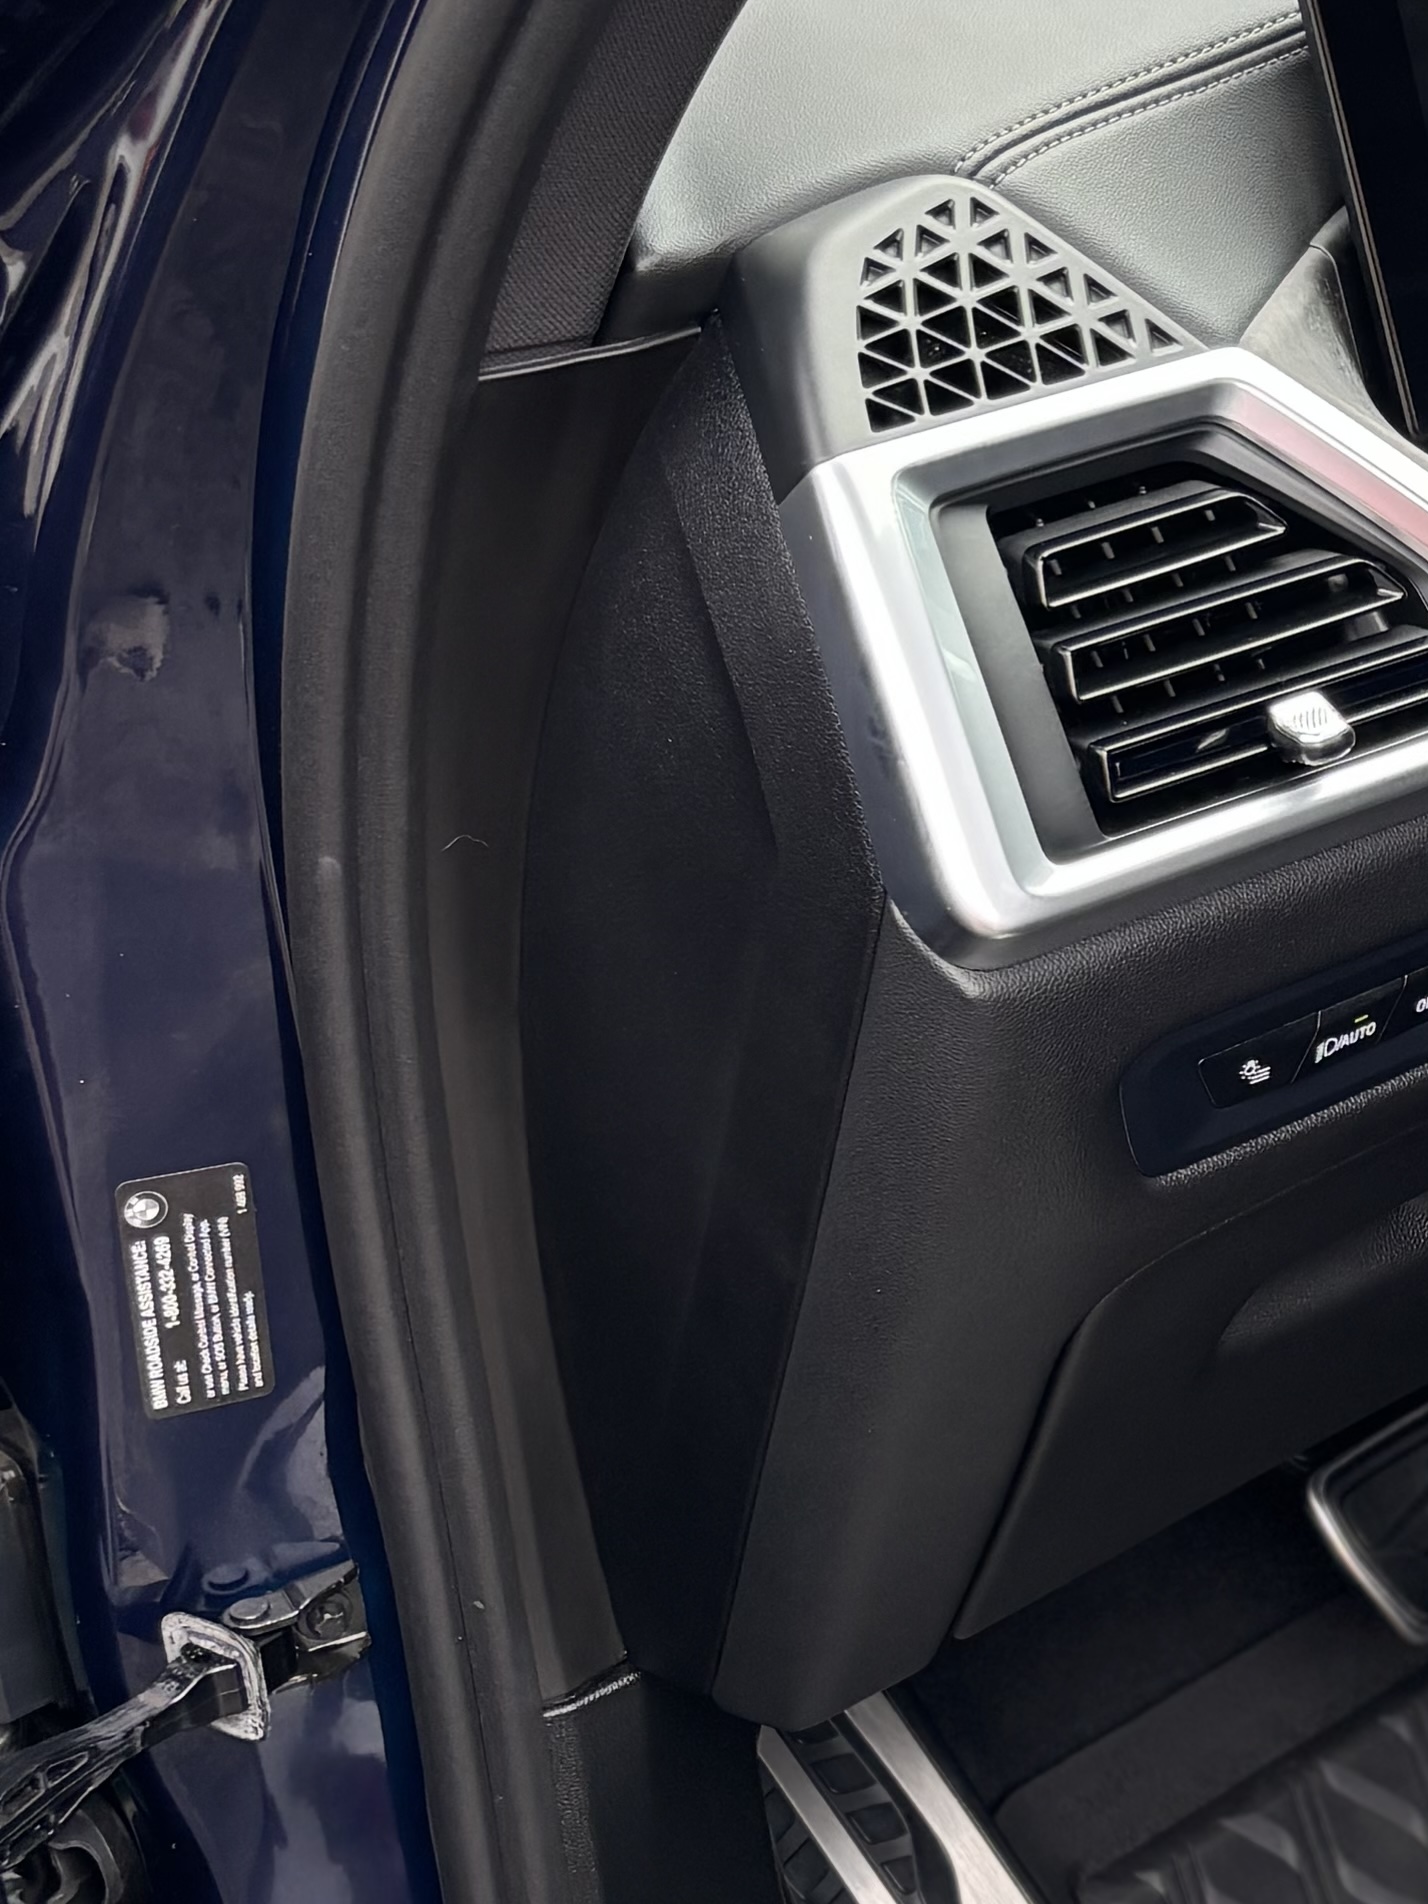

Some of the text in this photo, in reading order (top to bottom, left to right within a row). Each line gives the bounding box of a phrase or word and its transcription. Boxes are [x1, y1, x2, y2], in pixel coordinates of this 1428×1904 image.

[152, 1235, 181, 1329] 1-800-332-4269
[130, 1239, 169, 1410] BMW ROADSIDE ASSISTANCE:
[212, 1341, 226, 1362] SOS
[176, 1372, 190, 1386] us
[174, 1384, 192, 1405] Call
